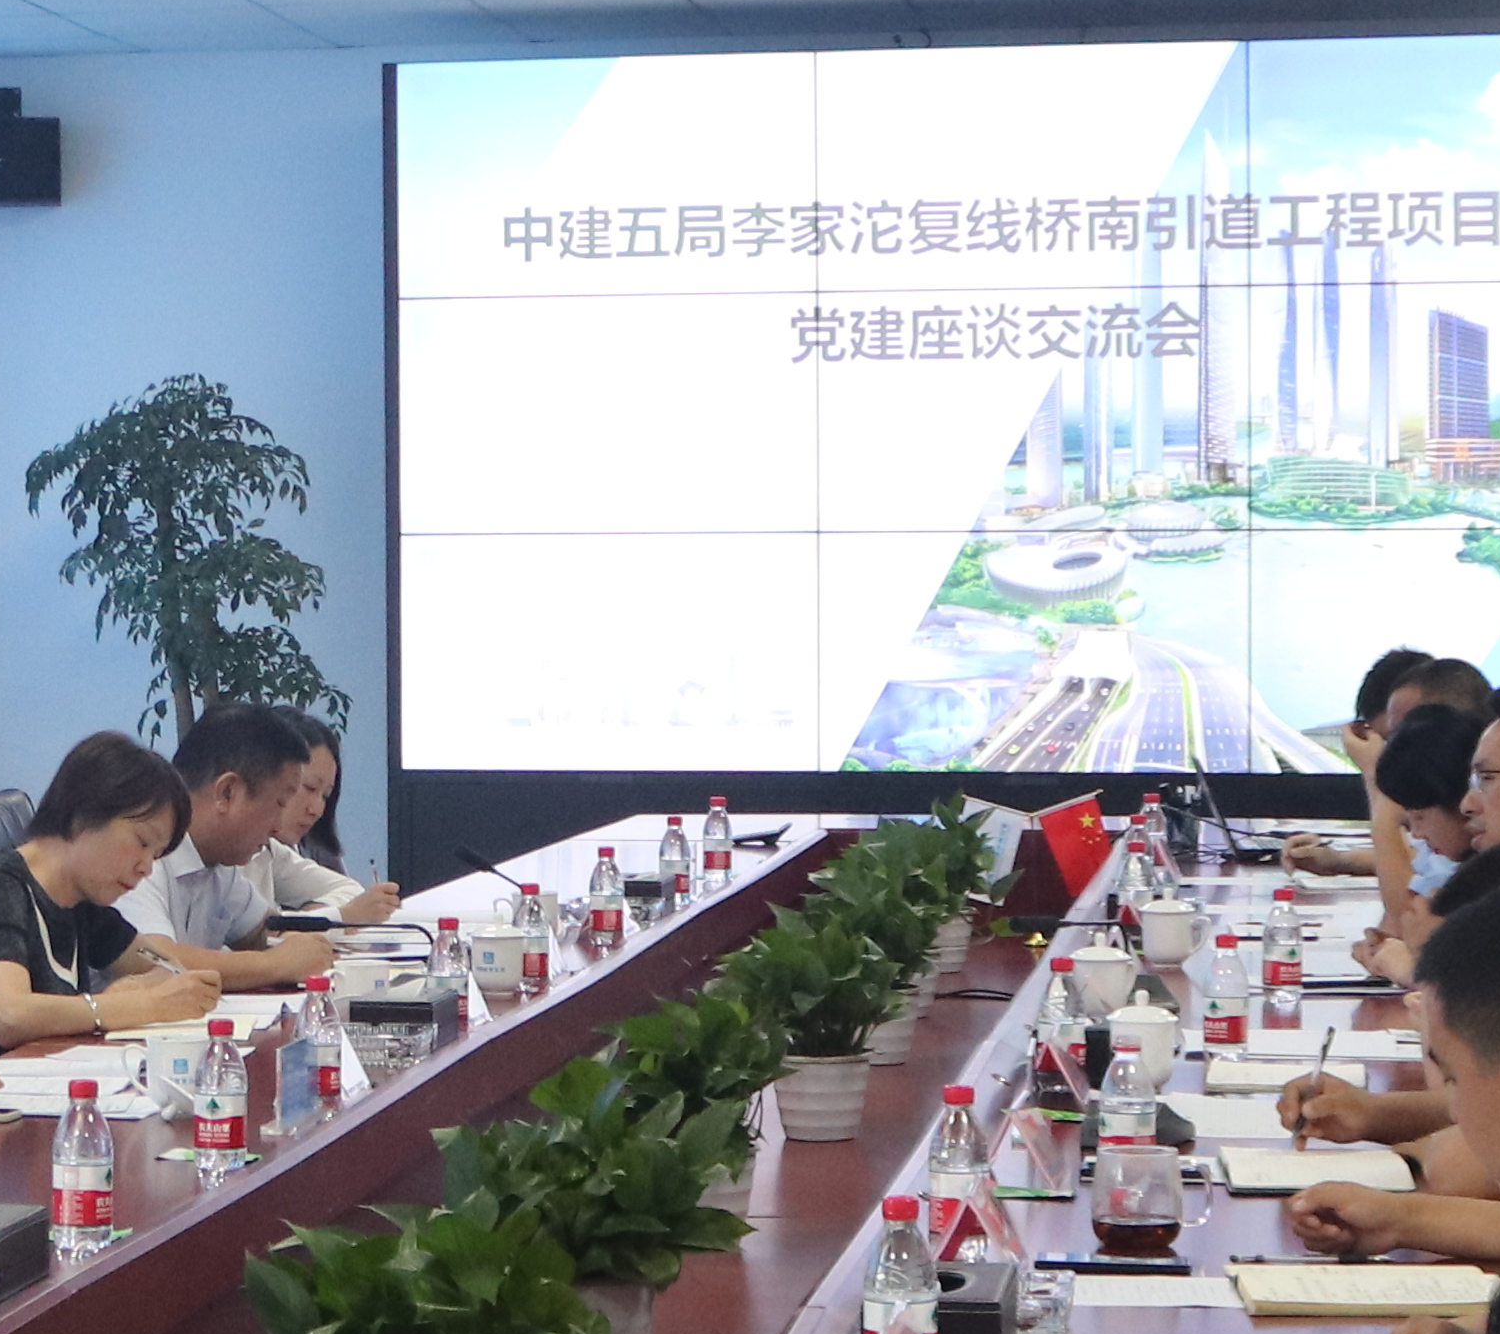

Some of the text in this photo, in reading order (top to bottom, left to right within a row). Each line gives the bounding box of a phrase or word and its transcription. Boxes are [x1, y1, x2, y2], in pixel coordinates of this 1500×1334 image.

[503, 190, 1500, 262] 中建五局李家沱复线桥南引道工程项目
[790, 300, 1202, 364] 党建座谈交流会
